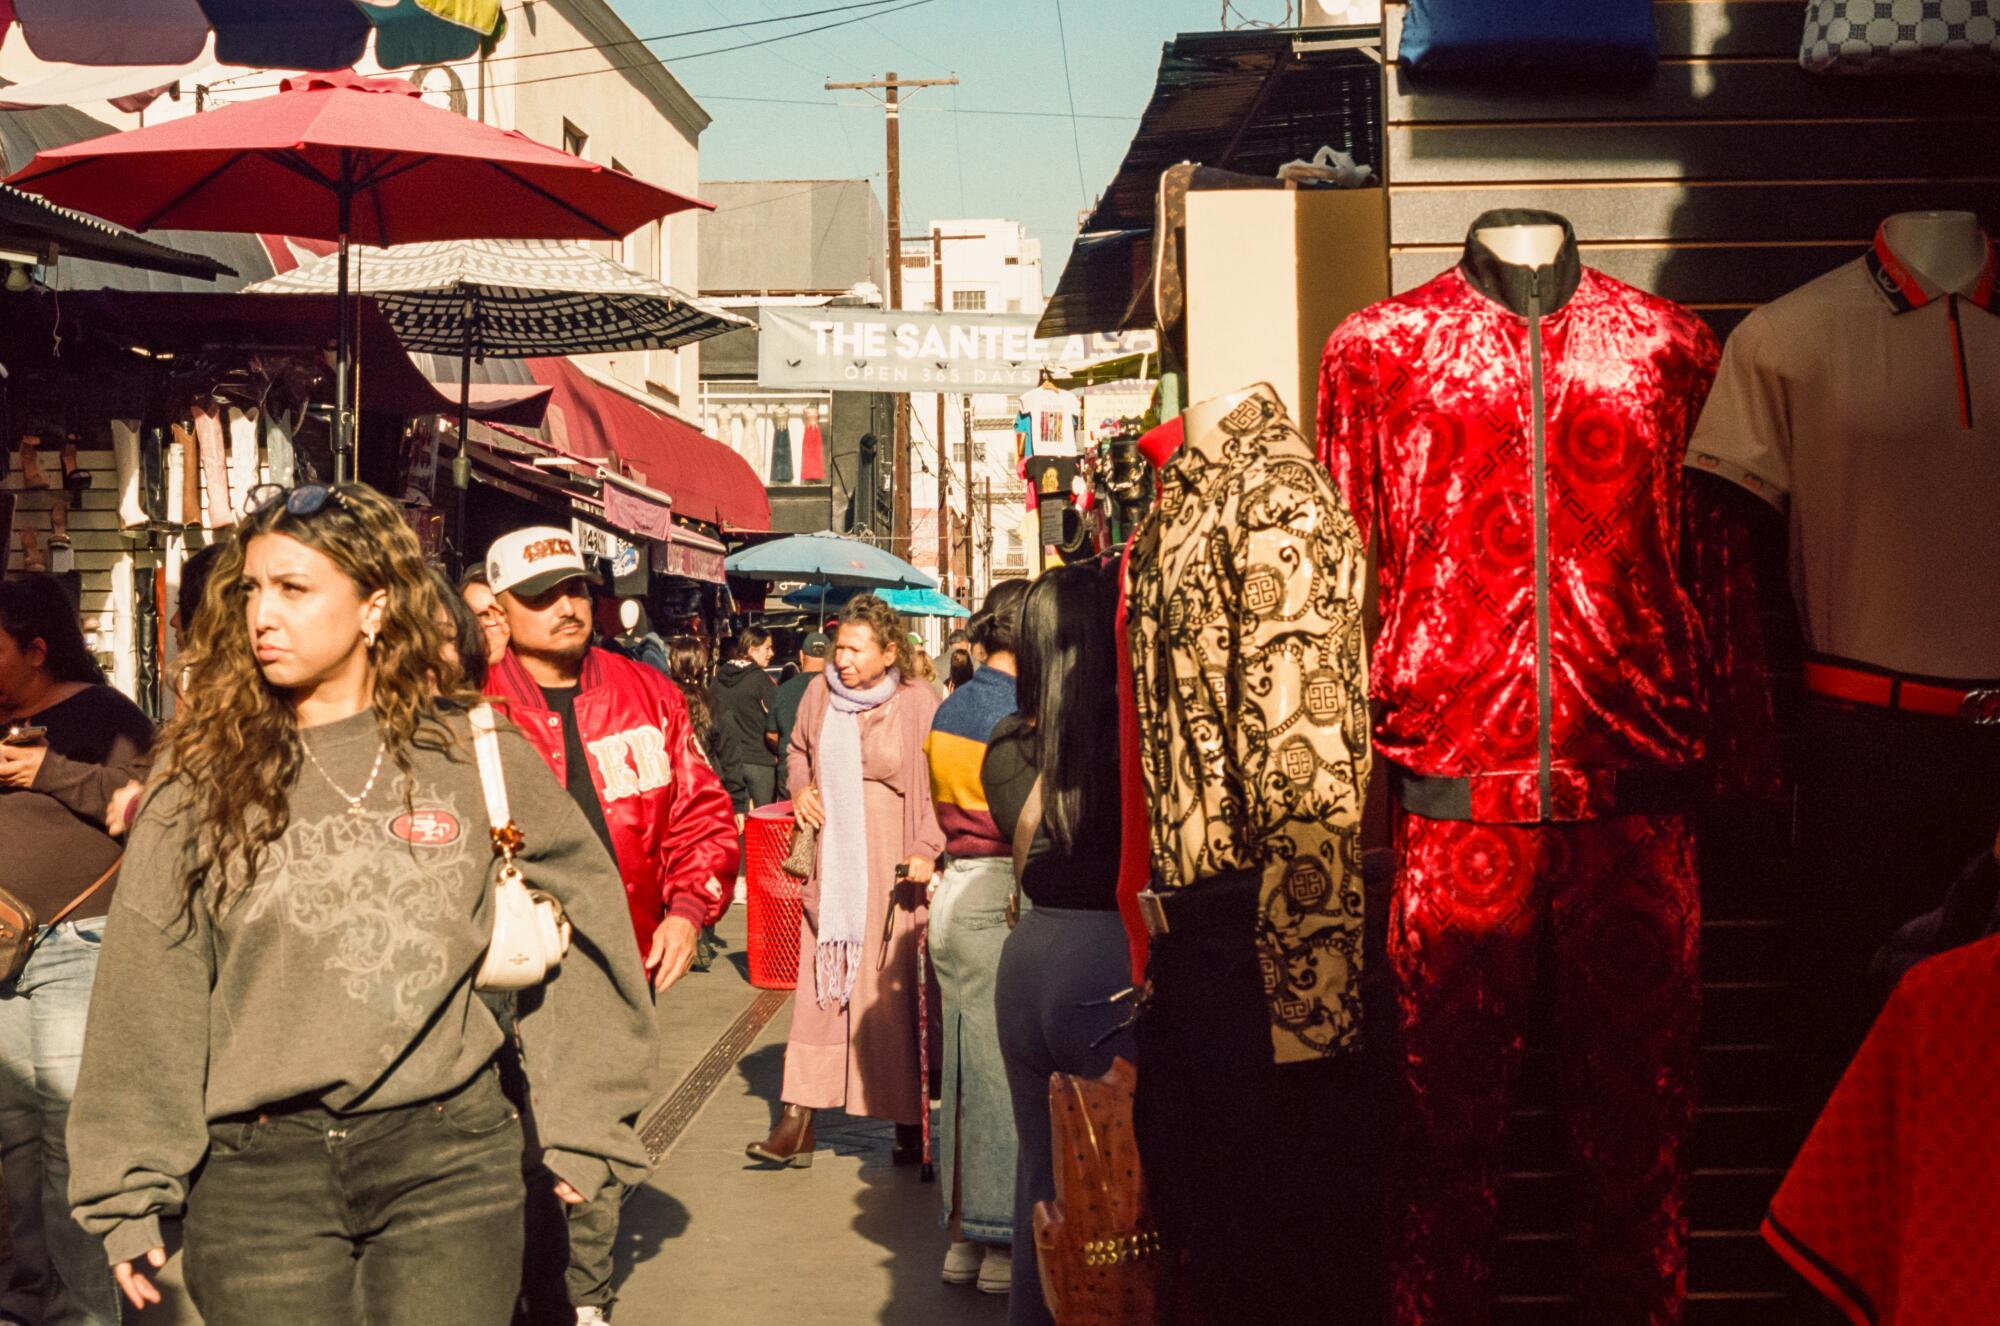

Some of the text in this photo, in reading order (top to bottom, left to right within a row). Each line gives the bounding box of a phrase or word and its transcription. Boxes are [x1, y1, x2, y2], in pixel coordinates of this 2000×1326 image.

[809, 320, 887, 357] THE
[896, 322, 1050, 361] SANTEE
[844, 365, 1033, 384] OPEN 365 DAYS
